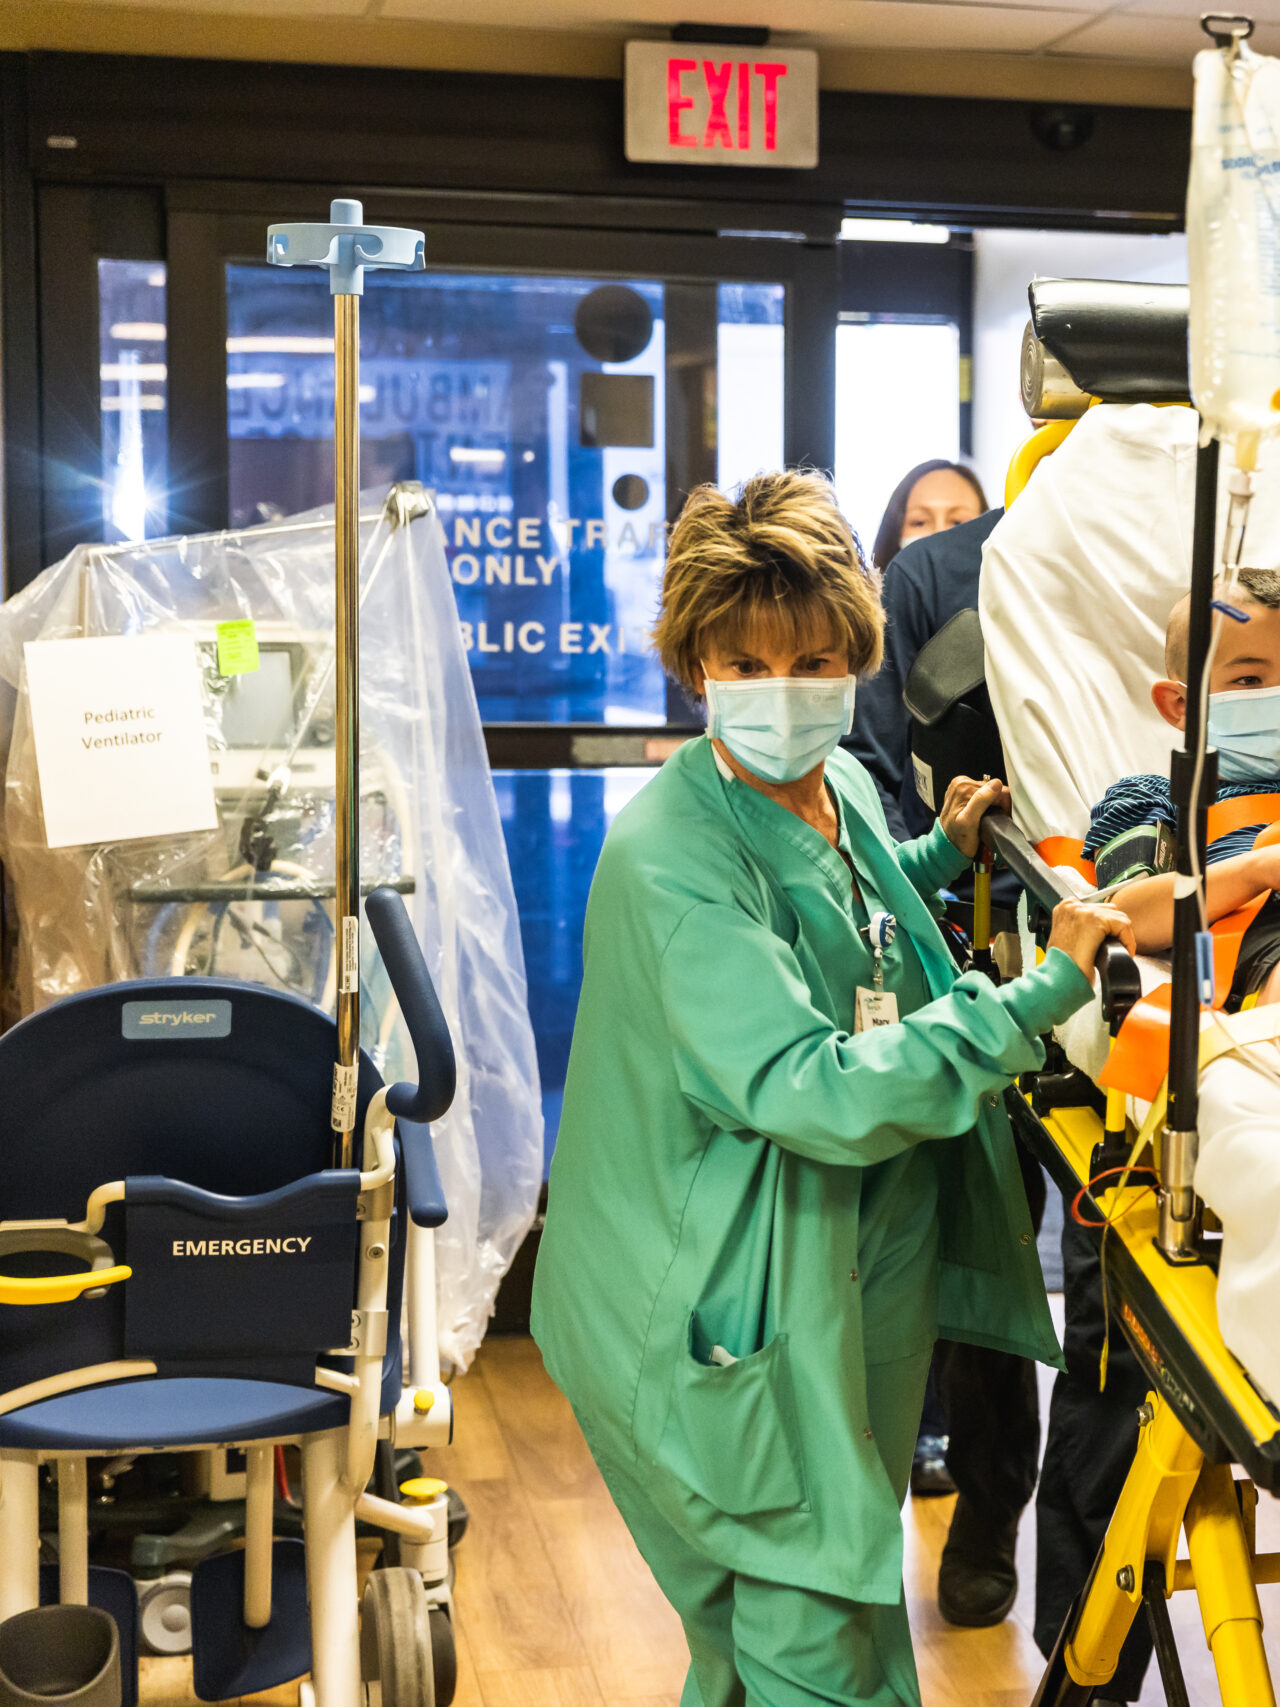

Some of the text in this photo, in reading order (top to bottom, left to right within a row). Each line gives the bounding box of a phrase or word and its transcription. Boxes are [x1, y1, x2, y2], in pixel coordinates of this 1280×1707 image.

[667, 58, 787, 151] EXIT
[440, 517, 542, 549] NCE
[452, 554, 558, 586] ONLY
[84, 705, 156, 725] Pediatric
[81, 732, 162, 749] Ventilator
[139, 1011, 217, 1026] stryker
[172, 1237, 312, 1256] EMERGENCY
